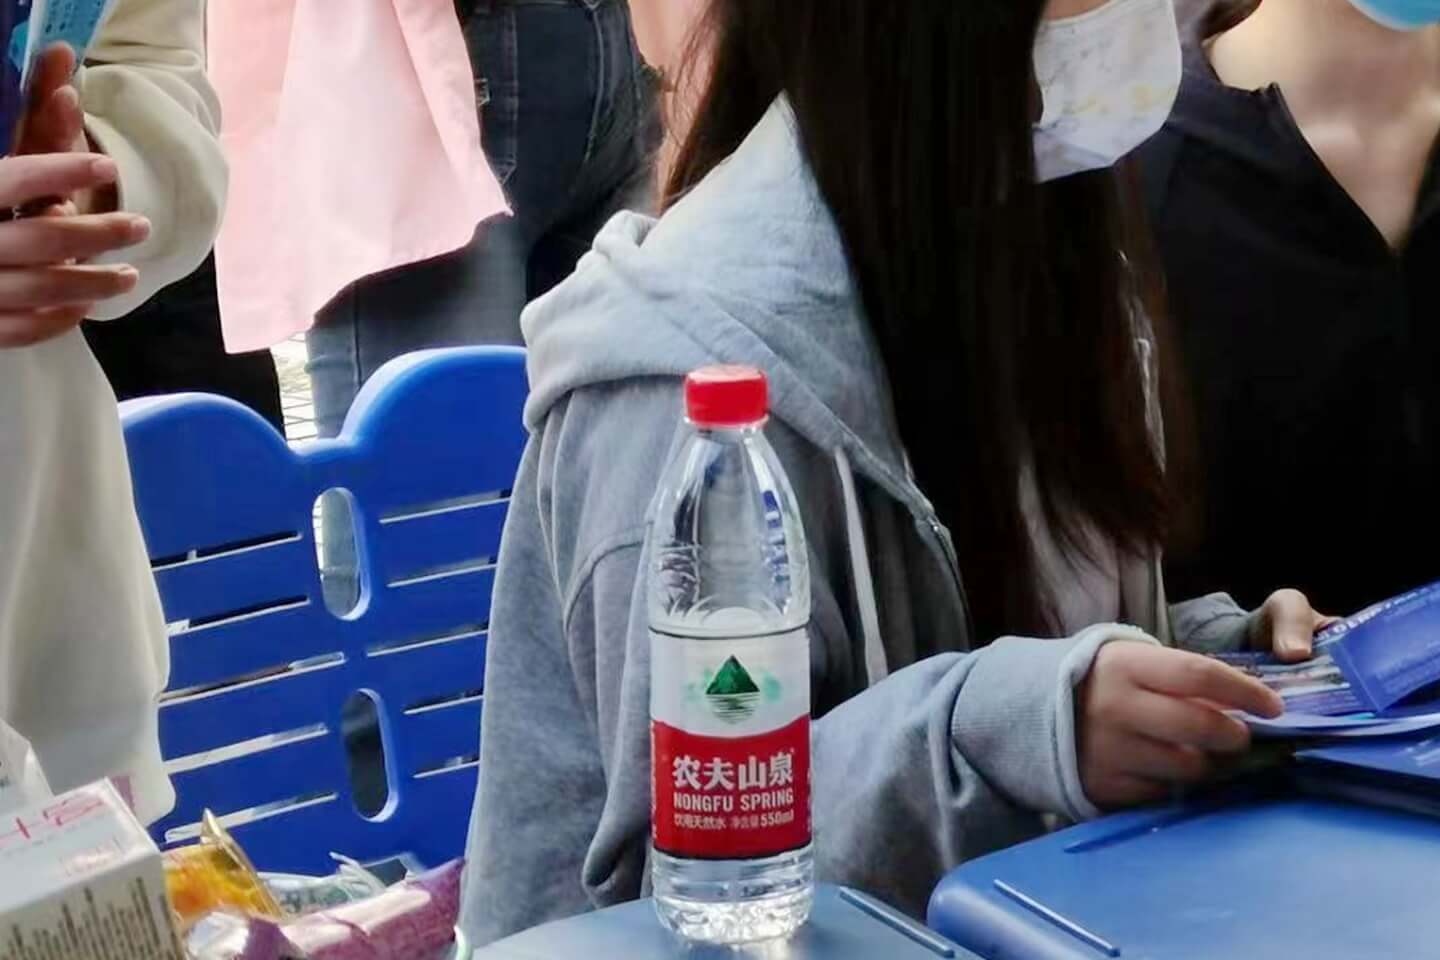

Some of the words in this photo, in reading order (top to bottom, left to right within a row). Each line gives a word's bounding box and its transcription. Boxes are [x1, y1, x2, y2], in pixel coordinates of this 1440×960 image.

[672, 751, 794, 791] 农夫山泉
[673, 791, 734, 813] NONGFU
[740, 787, 794, 812] SPRING
